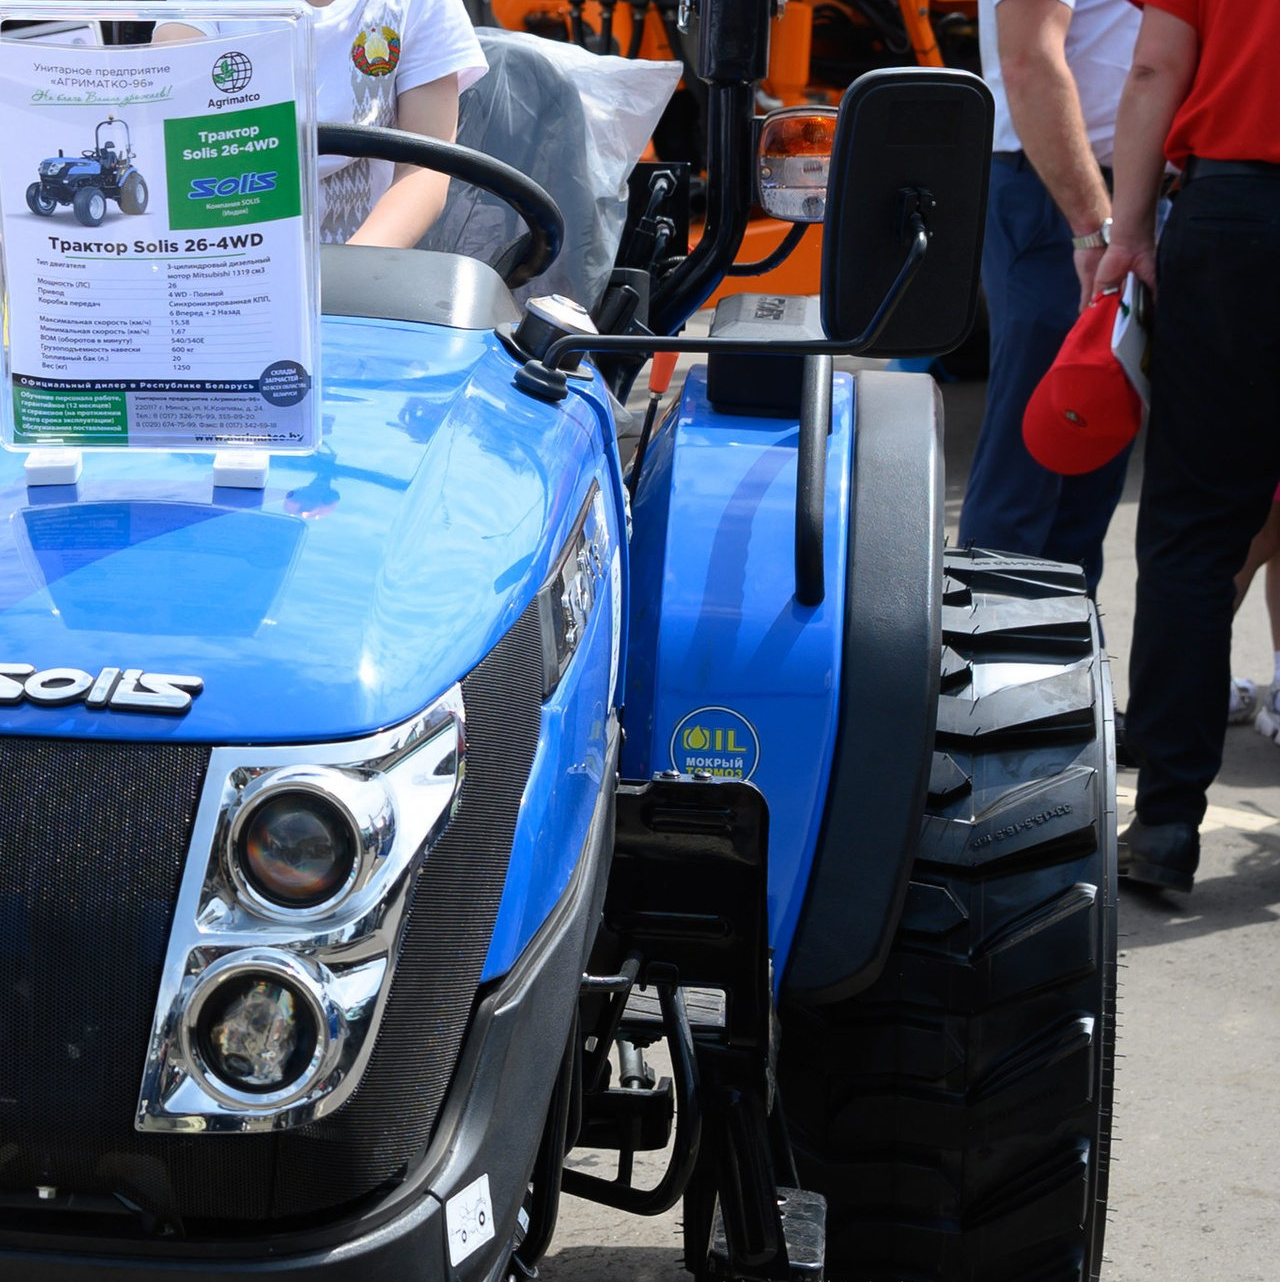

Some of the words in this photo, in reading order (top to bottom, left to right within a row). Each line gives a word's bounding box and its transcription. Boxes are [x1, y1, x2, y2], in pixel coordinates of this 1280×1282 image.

[33, 63, 92, 75] Унитарное
[95, 65, 171, 77] предприятие
[50, 77, 154, 89] «АГРИМАТКО-96»
[208, 93, 261, 109] Agrimatco
[198, 125, 260, 144] Трактор
[182, 147, 218, 161] Solis
[221, 137, 279, 157] 26-4WD
[241, 197, 260, 206] SOLIS
[48, 236, 128, 255] Трактор
[133, 239, 179, 253] Solis
[184, 233, 264, 252] 26-4WD
[49, 261, 86, 269] двигателя
[167, 261, 227, 270] 3-цилиндровый
[228, 256, 271, 267] дизельный
[192, 270, 230, 279] Mitsubishi
[233, 269, 250, 277] 1319
[251, 267, 265, 275] см3
[37, 278, 74, 287] Мощность
[75, 281, 90, 289] (ЛС)
[37, 287, 65, 296] Привод
[38, 297, 68, 306] Коробка
[169, 298, 251, 308] Синхронизированная
[39, 315, 93, 325] Максимальная
[94, 319, 128, 327] скорость
[40, 325, 91, 334] Минимальная
[40, 334, 57, 342] ВОМ
[58, 336, 96, 345] (оборотов
[40, 343, 109, 353] Грузоподъемность
[41, 353, 81, 361] Топливный
[20, 377, 91, 389] Официальный
[140, 382, 201, 390] Республике
[205, 382, 254, 390] Беларусь
[683, 725, 746, 752] OIL
[685, 757, 744, 769] МОКРЫЙ
